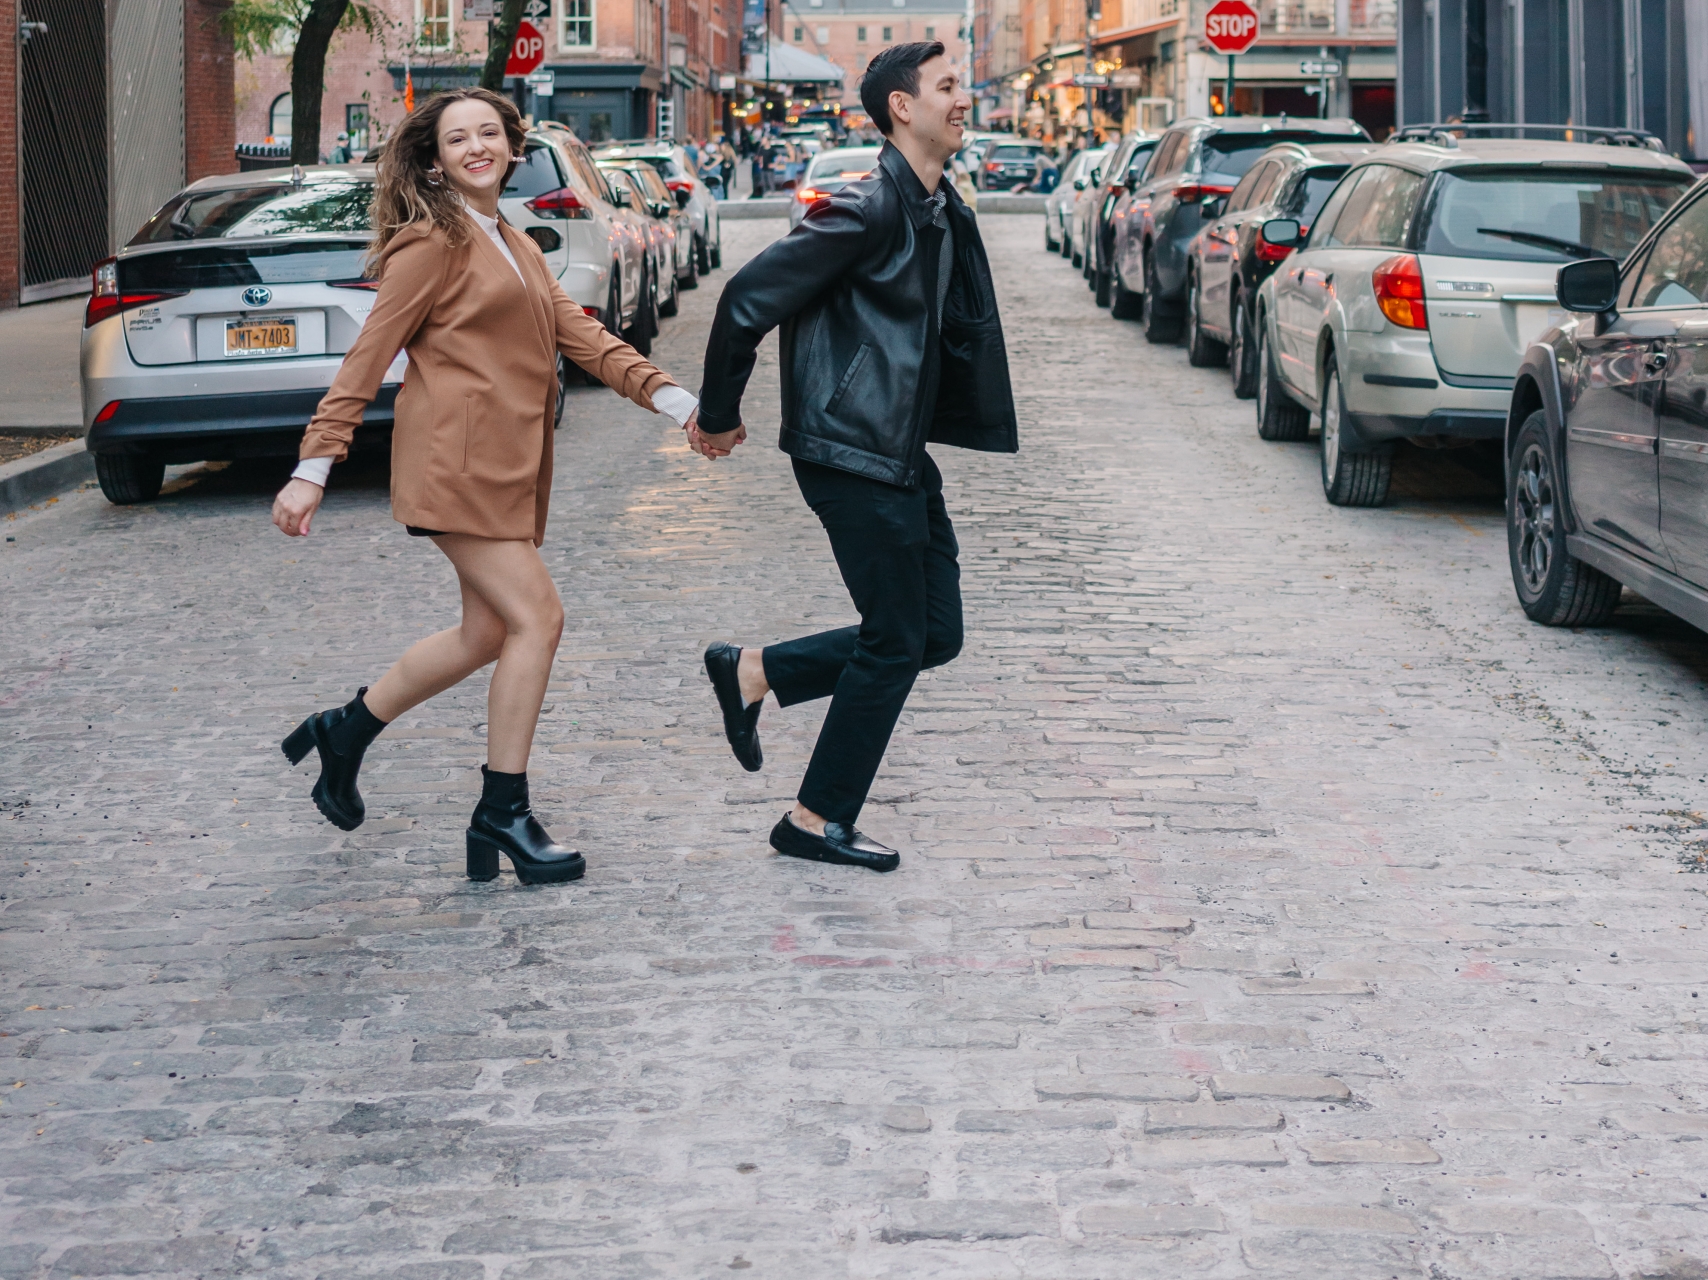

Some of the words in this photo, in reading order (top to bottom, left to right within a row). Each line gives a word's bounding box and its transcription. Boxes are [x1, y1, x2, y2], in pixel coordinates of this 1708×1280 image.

[1207, 14, 1256, 37] STOP
[510, 37, 543, 60] OP
[261, 327, 290, 346] 7403
